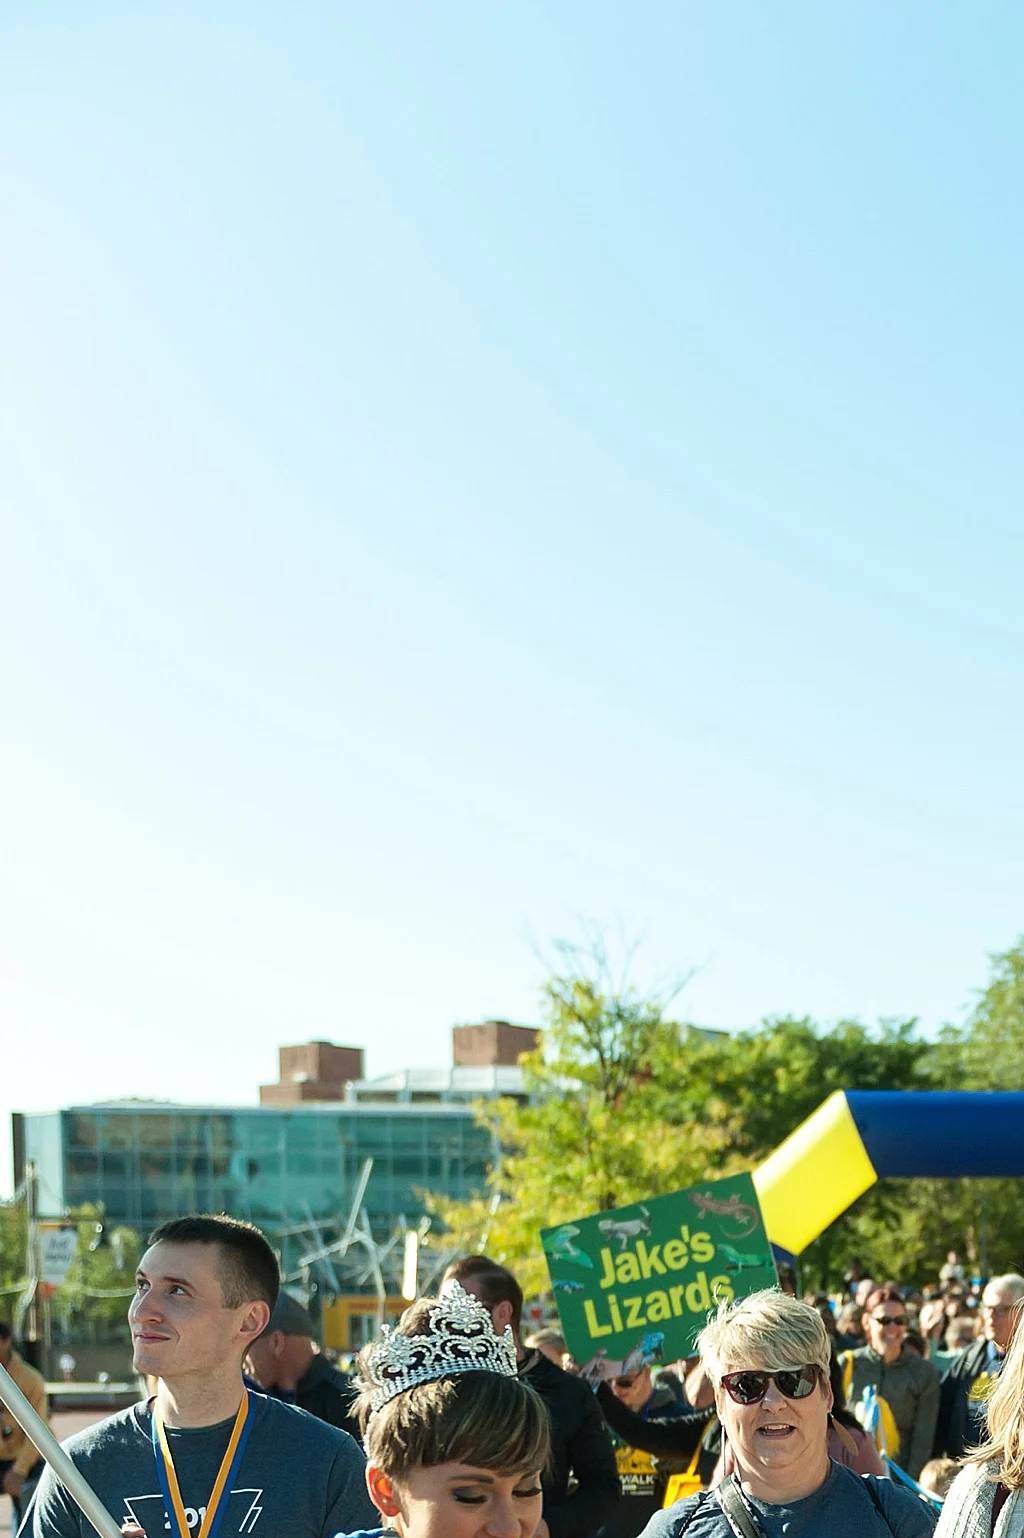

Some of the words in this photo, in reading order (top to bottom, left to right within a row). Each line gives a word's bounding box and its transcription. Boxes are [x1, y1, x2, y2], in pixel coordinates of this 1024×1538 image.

[599, 1225, 715, 1289] Jake's
[584, 1271, 735, 1338] Lizards
[619, 1474, 654, 1485] WALK
